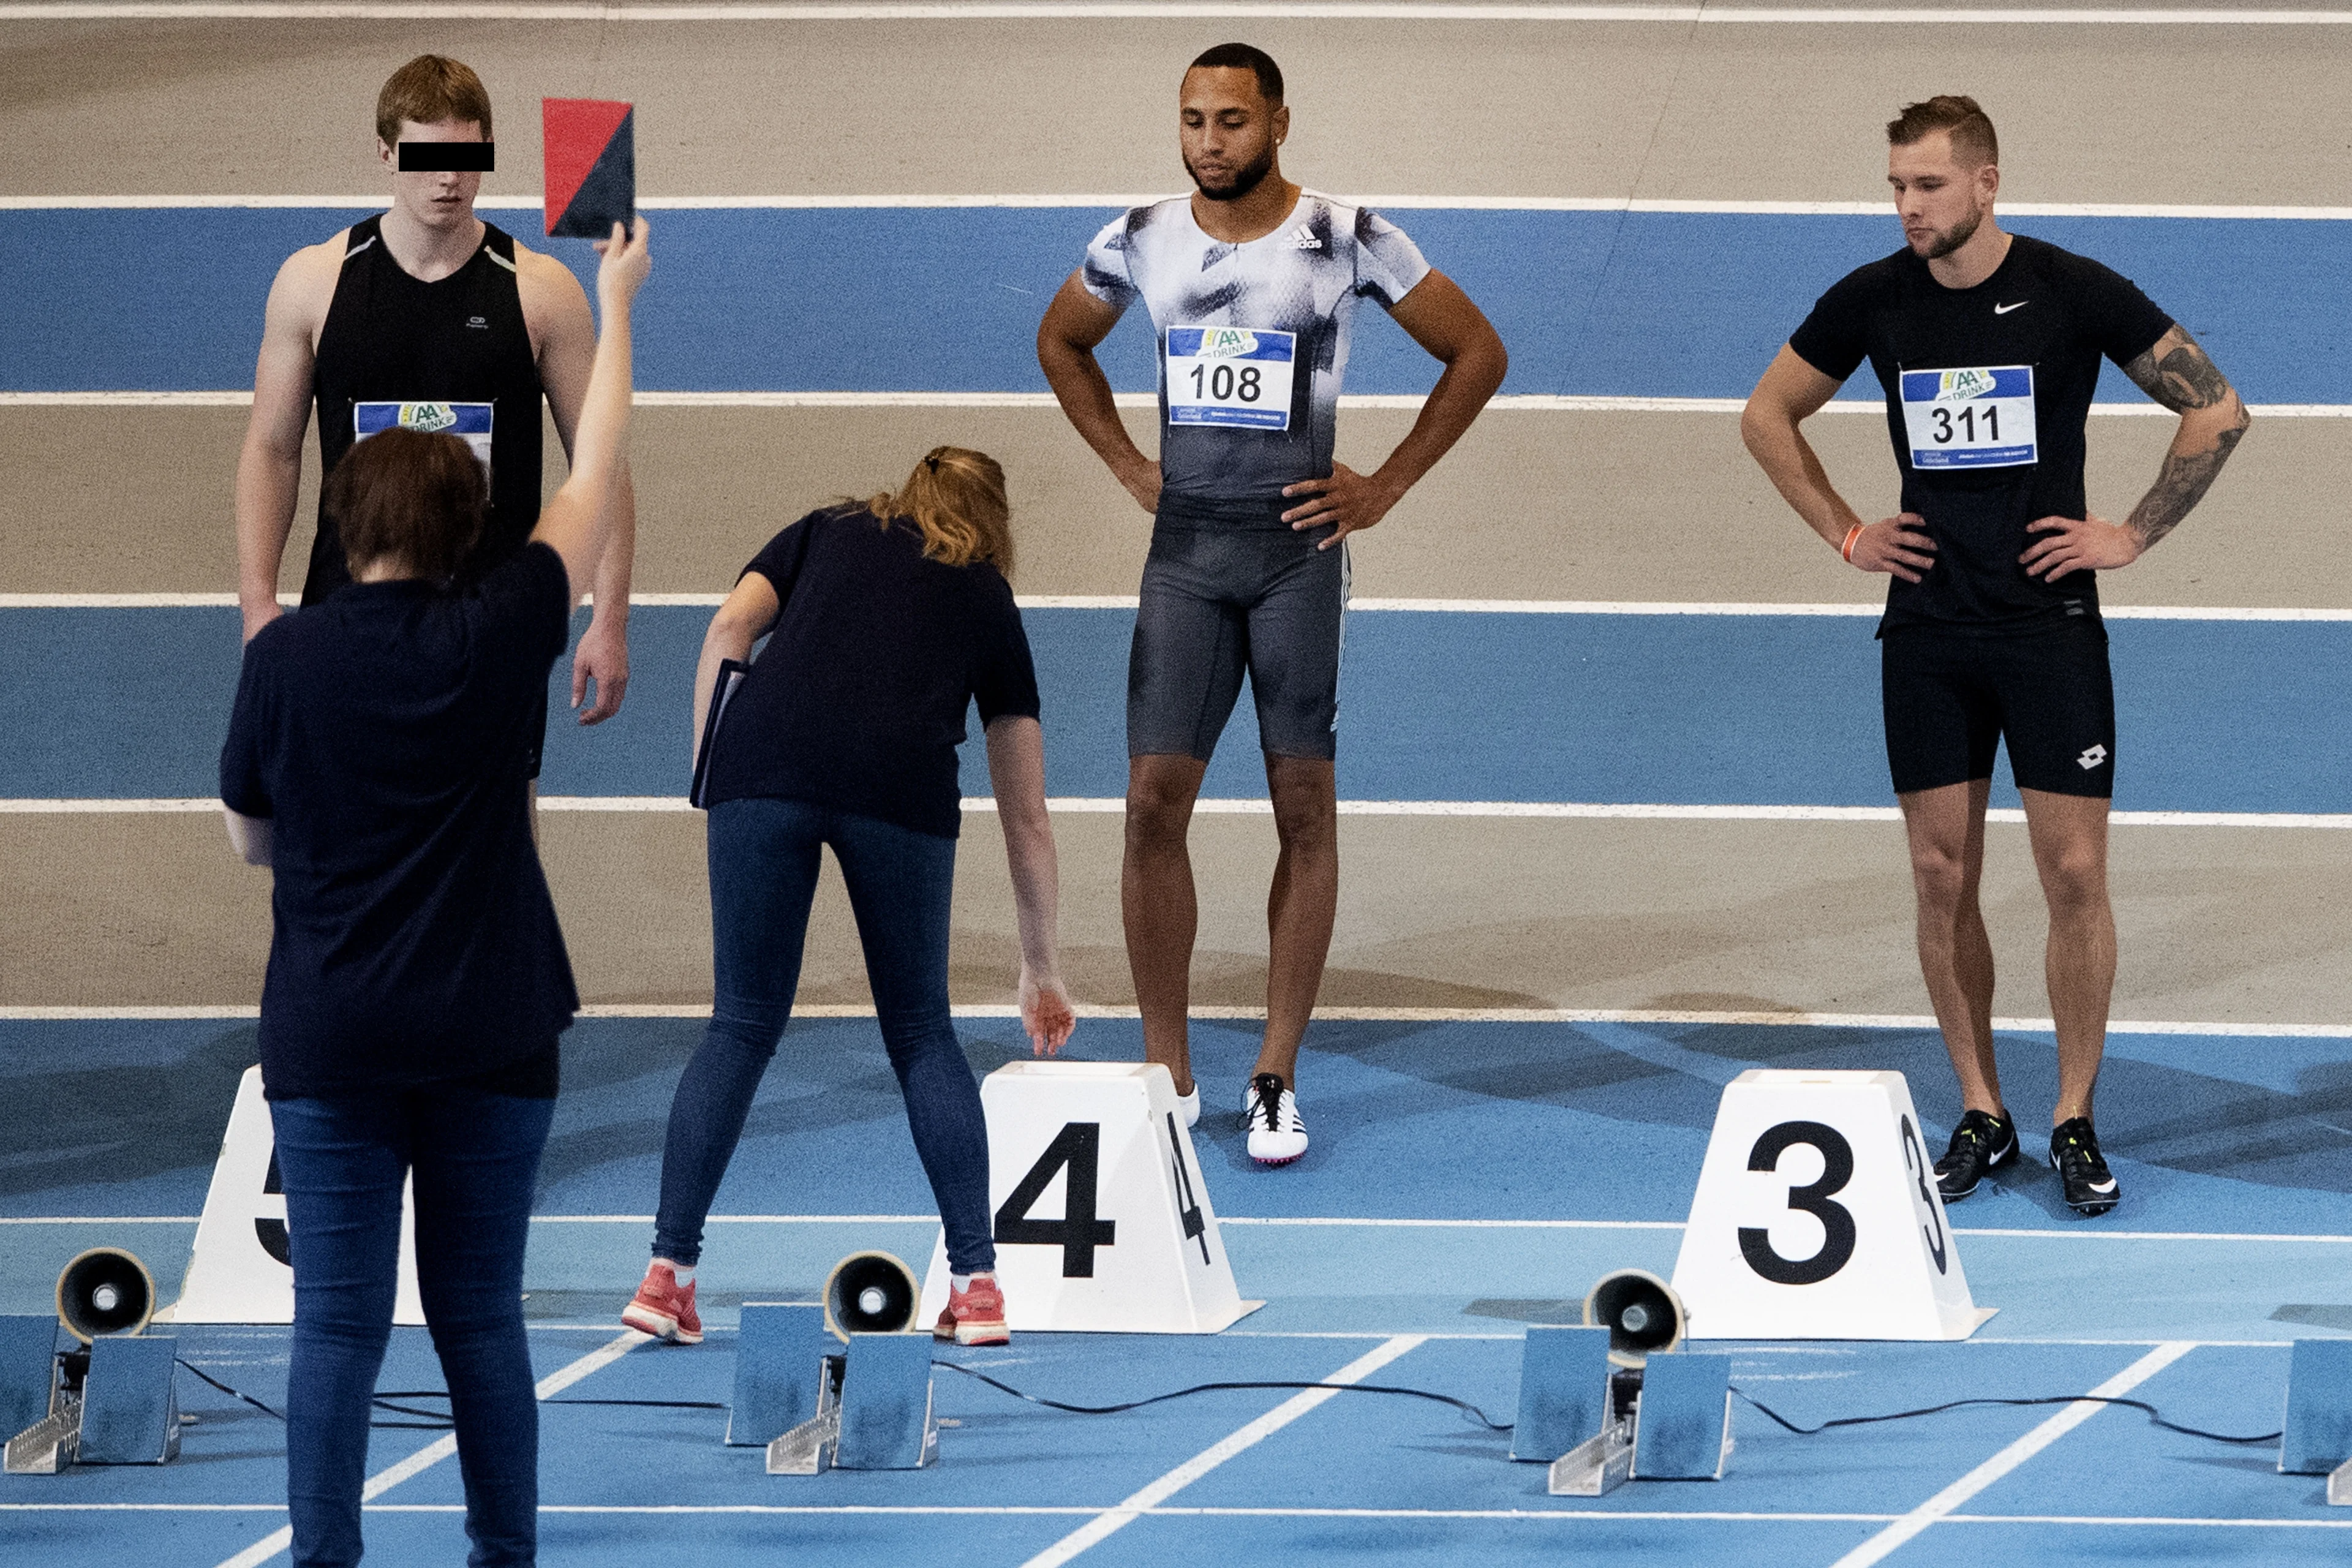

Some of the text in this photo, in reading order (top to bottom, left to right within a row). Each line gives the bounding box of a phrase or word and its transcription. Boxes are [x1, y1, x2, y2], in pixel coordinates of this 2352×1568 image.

[1280, 238, 1322, 249] adidas
[1213, 342, 1246, 358] DRINK
[1218, 330, 1242, 347] AA
[1191, 364, 1261, 402] 108
[1953, 382, 1985, 401] DRINK
[1956, 370, 1979, 390] AA
[415, 404, 440, 424] AA
[1932, 405, 1999, 443] 311
[994, 1122, 1116, 1278] 4
[1166, 1111, 1211, 1266] 4
[1738, 1121, 1856, 1285] 3
[1901, 1114, 1947, 1275] 3
